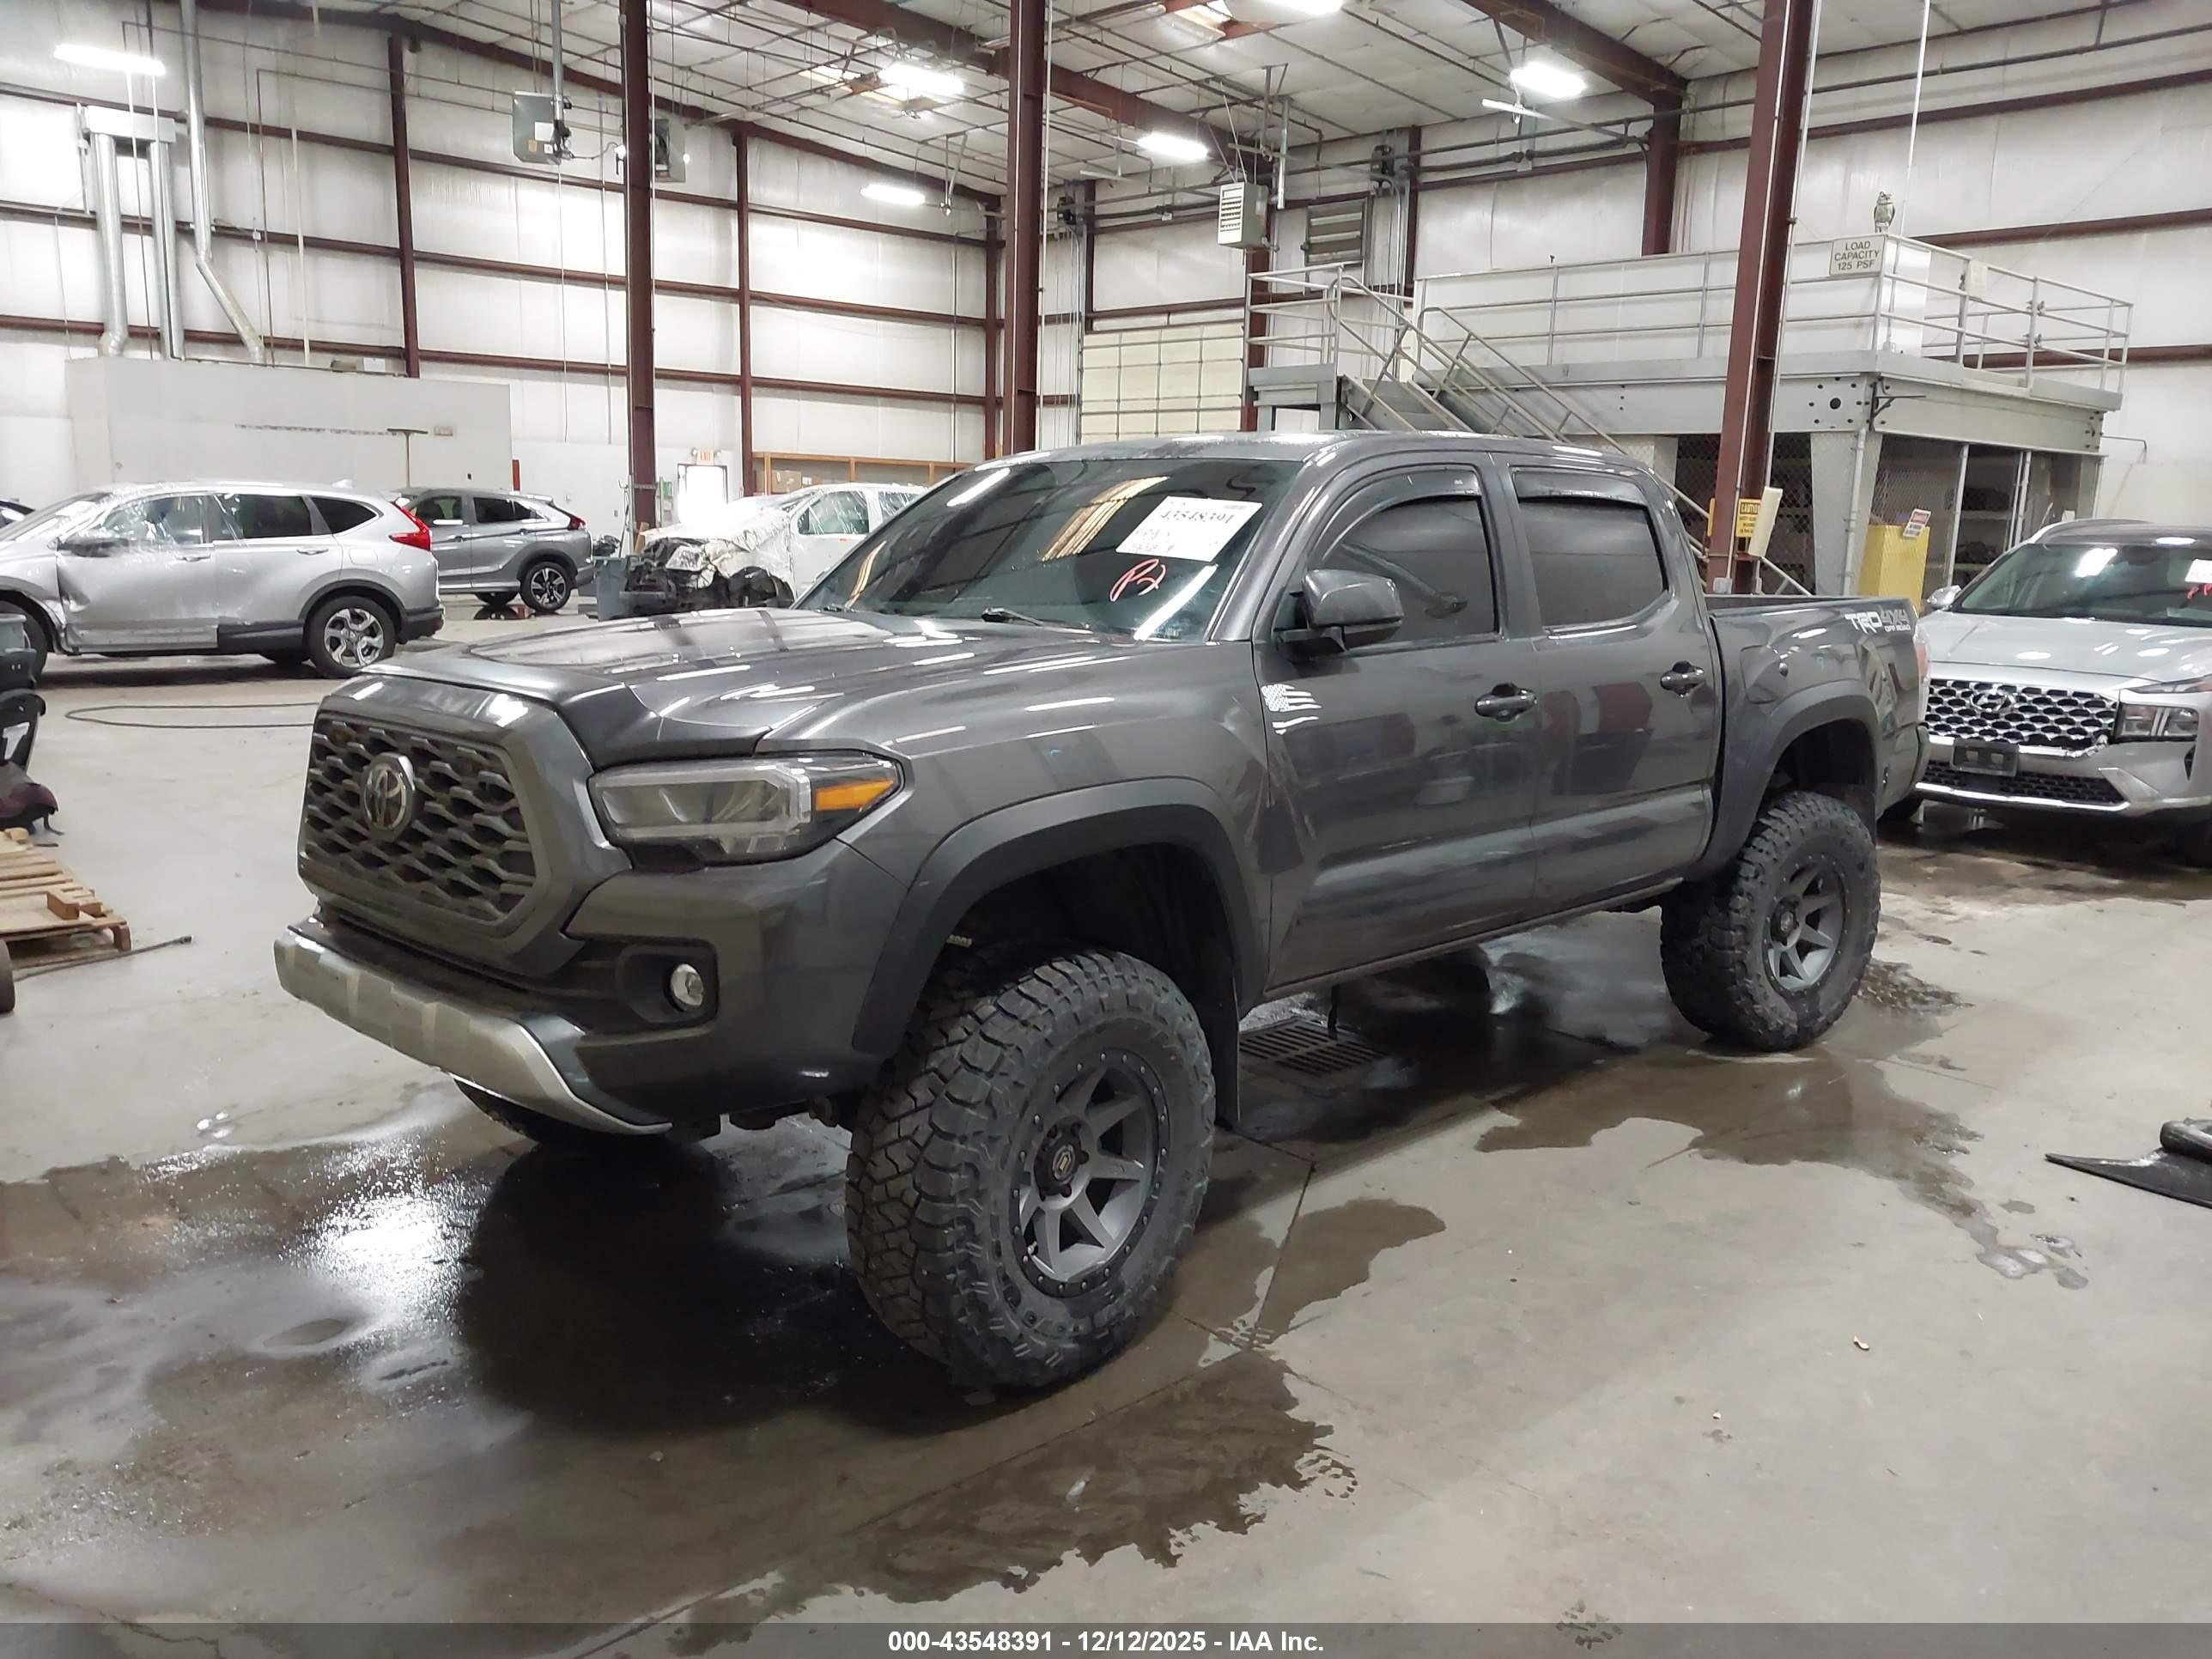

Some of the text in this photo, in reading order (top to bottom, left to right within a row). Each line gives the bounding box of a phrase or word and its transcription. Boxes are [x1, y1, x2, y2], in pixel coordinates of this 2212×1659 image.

[1844, 240, 1870, 251] LOAD
[1834, 249, 1880, 261] CAPACITY
[1838, 260, 1875, 270] 125 PSF
[1844, 611, 1883, 635] TRD
